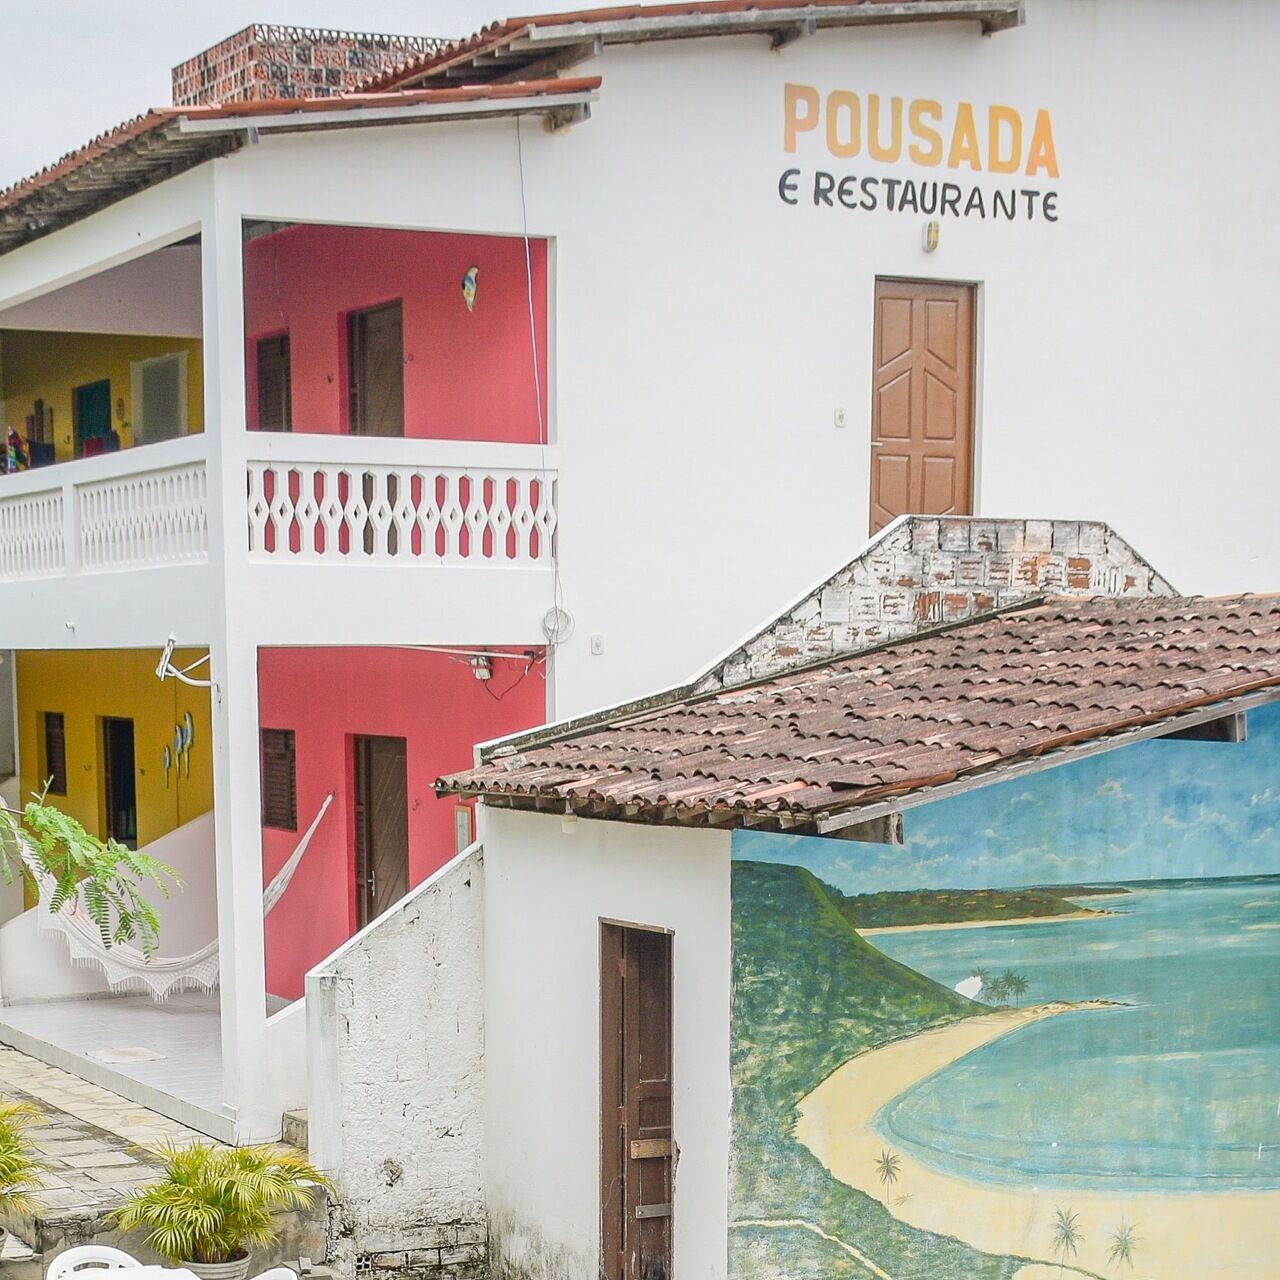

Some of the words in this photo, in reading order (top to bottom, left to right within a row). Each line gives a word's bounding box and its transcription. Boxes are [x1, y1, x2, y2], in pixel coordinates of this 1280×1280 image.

[783, 83, 1060, 178] POUSADA
[778, 169, 801, 204] E
[813, 171, 1059, 222] RESTAURANTE
